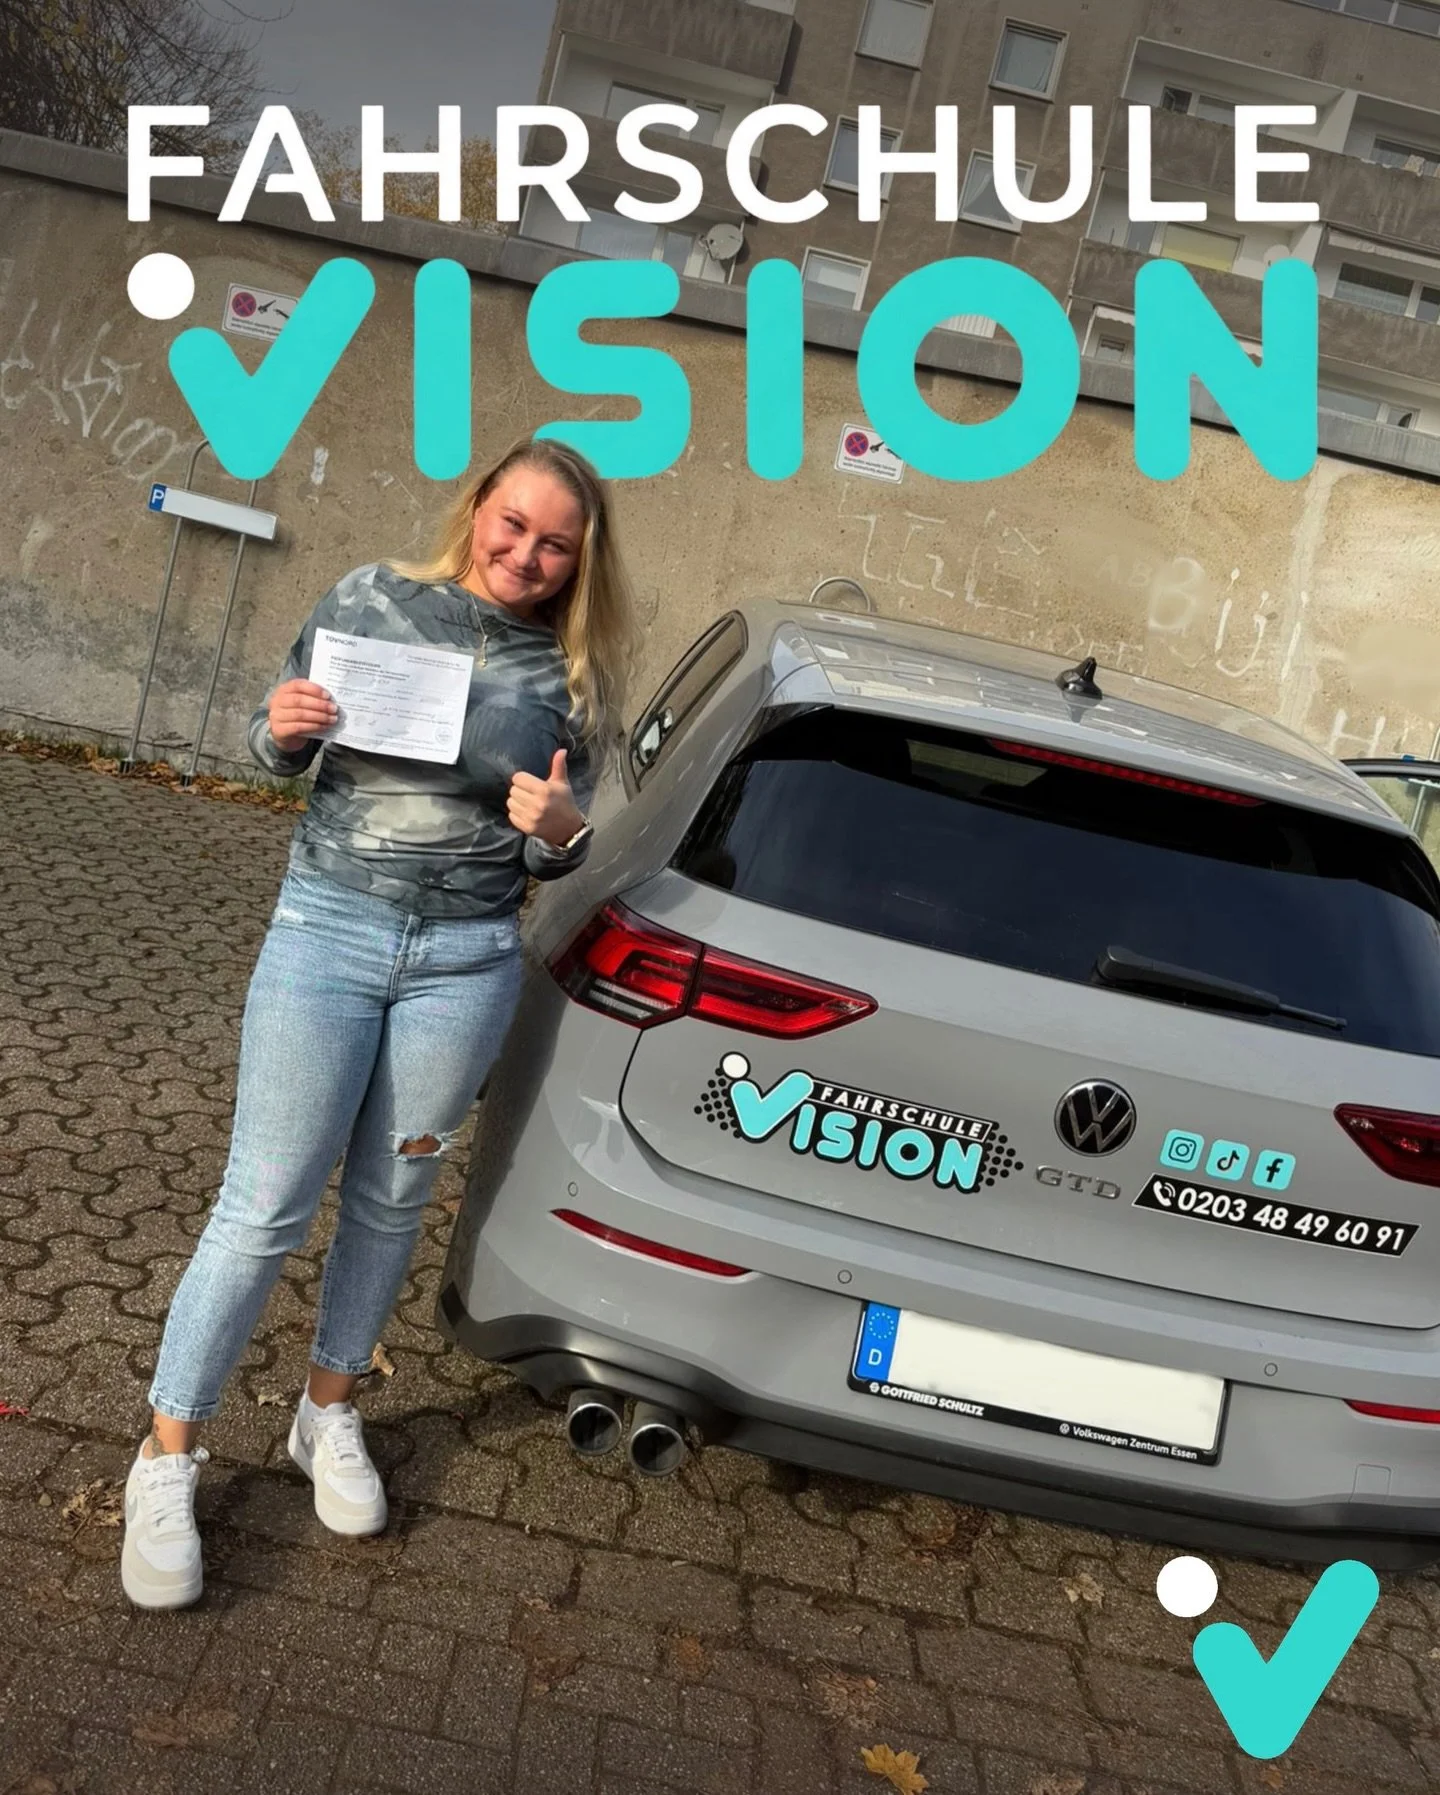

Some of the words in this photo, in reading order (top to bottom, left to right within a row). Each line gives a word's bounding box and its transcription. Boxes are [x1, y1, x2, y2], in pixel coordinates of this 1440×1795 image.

[151, 488, 164, 503] P
[820, 1086, 983, 1139] FAHRSCHULE
[730, 1071, 984, 1190] VISION
[1036, 1165, 1121, 1200] GTD
[1177, 1187, 1248, 1222] 0203
[1253, 1204, 1289, 1231] 48
[1294, 1212, 1330, 1238] 49
[1334, 1219, 1370, 1245] 60
[1375, 1225, 1405, 1251] 91
[867, 1348, 883, 1366] D
[880, 1384, 938, 1406] GOTTFRIED
[938, 1397, 985, 1417] SCHULTZ
[1073, 1425, 1129, 1446] Volkswagen
[1129, 1437, 1170, 1455] Zentrum
[1171, 1446, 1198, 1460] Essen
